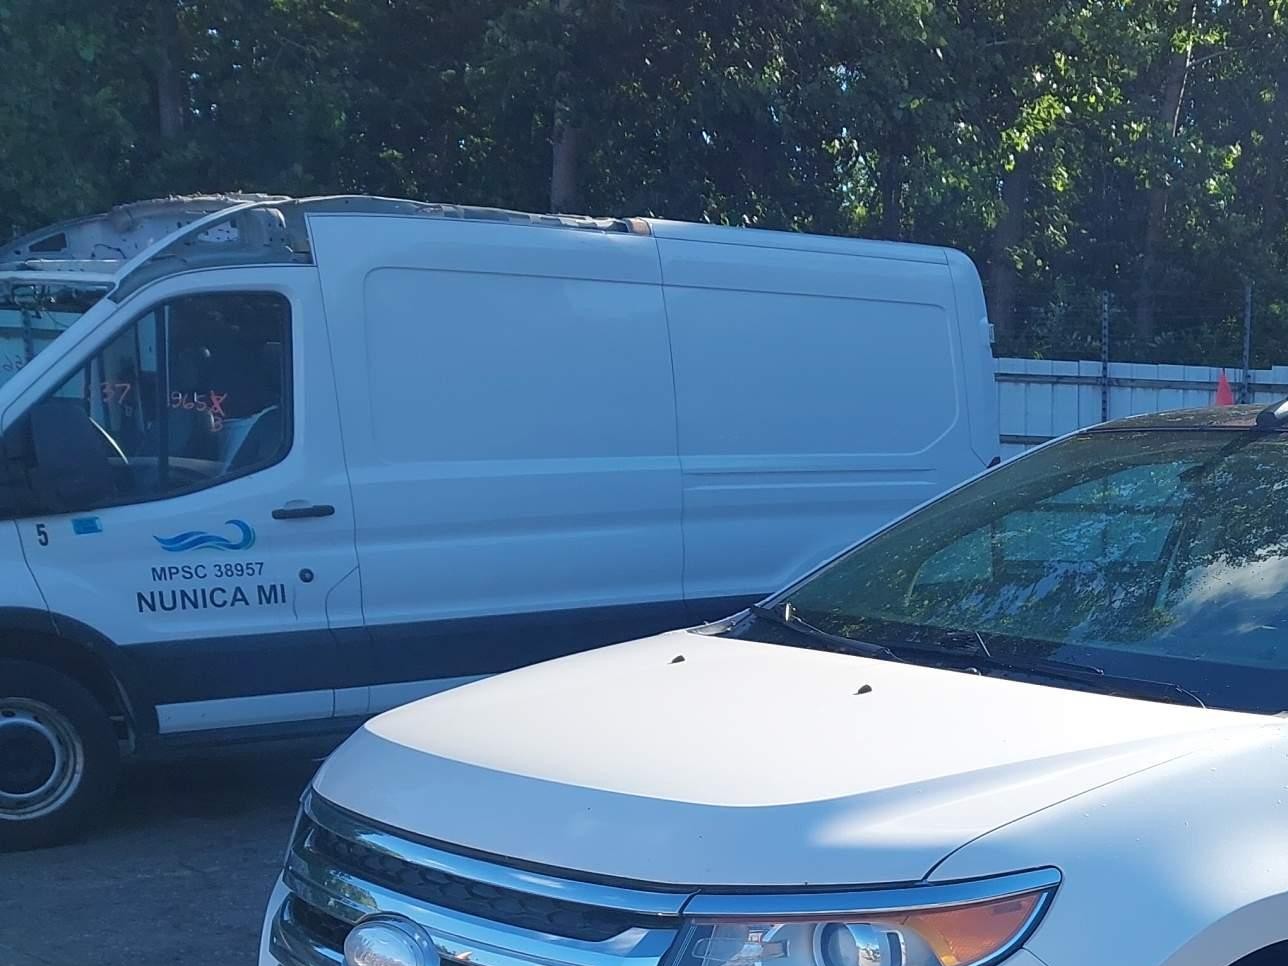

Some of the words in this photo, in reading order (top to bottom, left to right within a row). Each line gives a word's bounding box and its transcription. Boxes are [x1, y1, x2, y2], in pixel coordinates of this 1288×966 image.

[36, 523, 49, 546] 5
[151, 564, 207, 582] MPSC
[213, 562, 265, 578] 38957
[136, 586, 250, 613] NUNICA
[257, 584, 287, 605] MI
